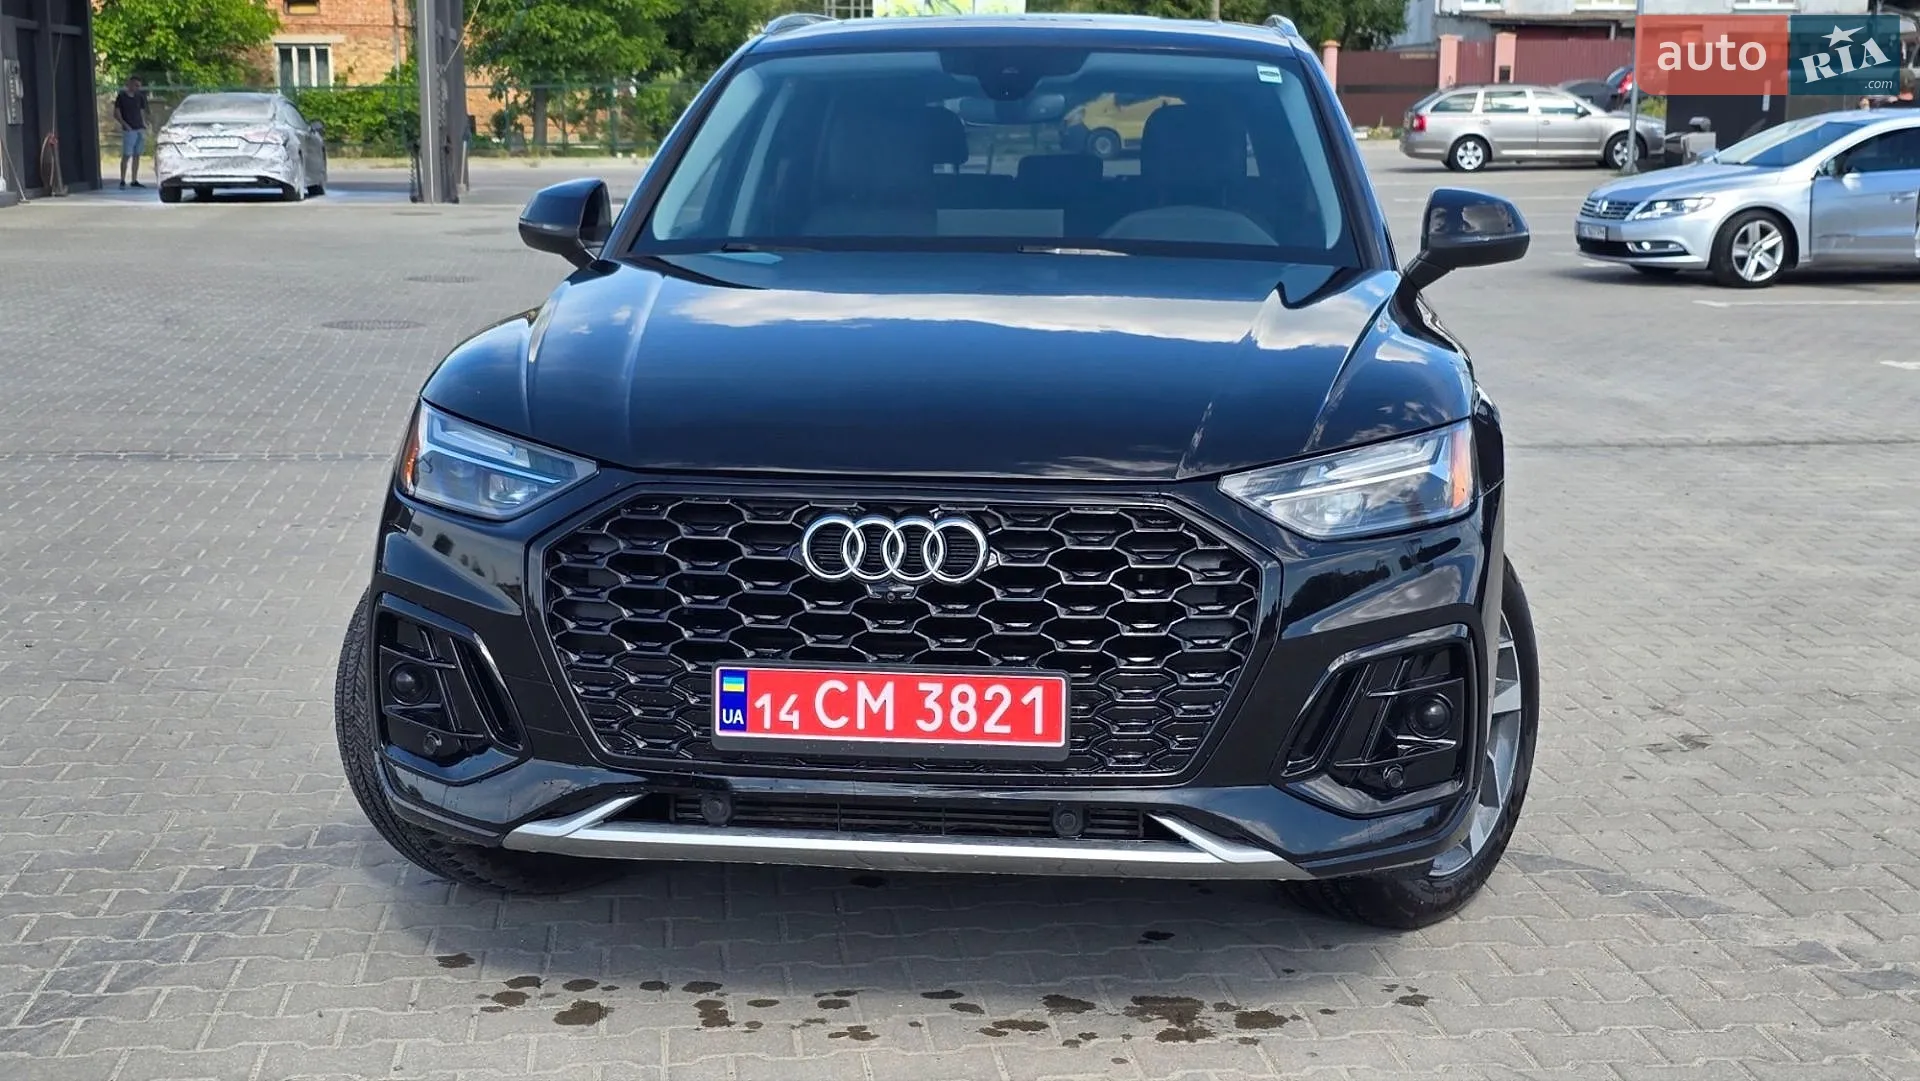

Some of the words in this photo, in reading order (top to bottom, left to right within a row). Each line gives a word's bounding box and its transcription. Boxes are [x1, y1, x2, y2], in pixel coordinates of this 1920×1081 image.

[722, 708, 744, 725] UA
[754, 693, 800, 730] 14
[814, 679, 895, 731] CM
[915, 682, 1044, 735] 3821
